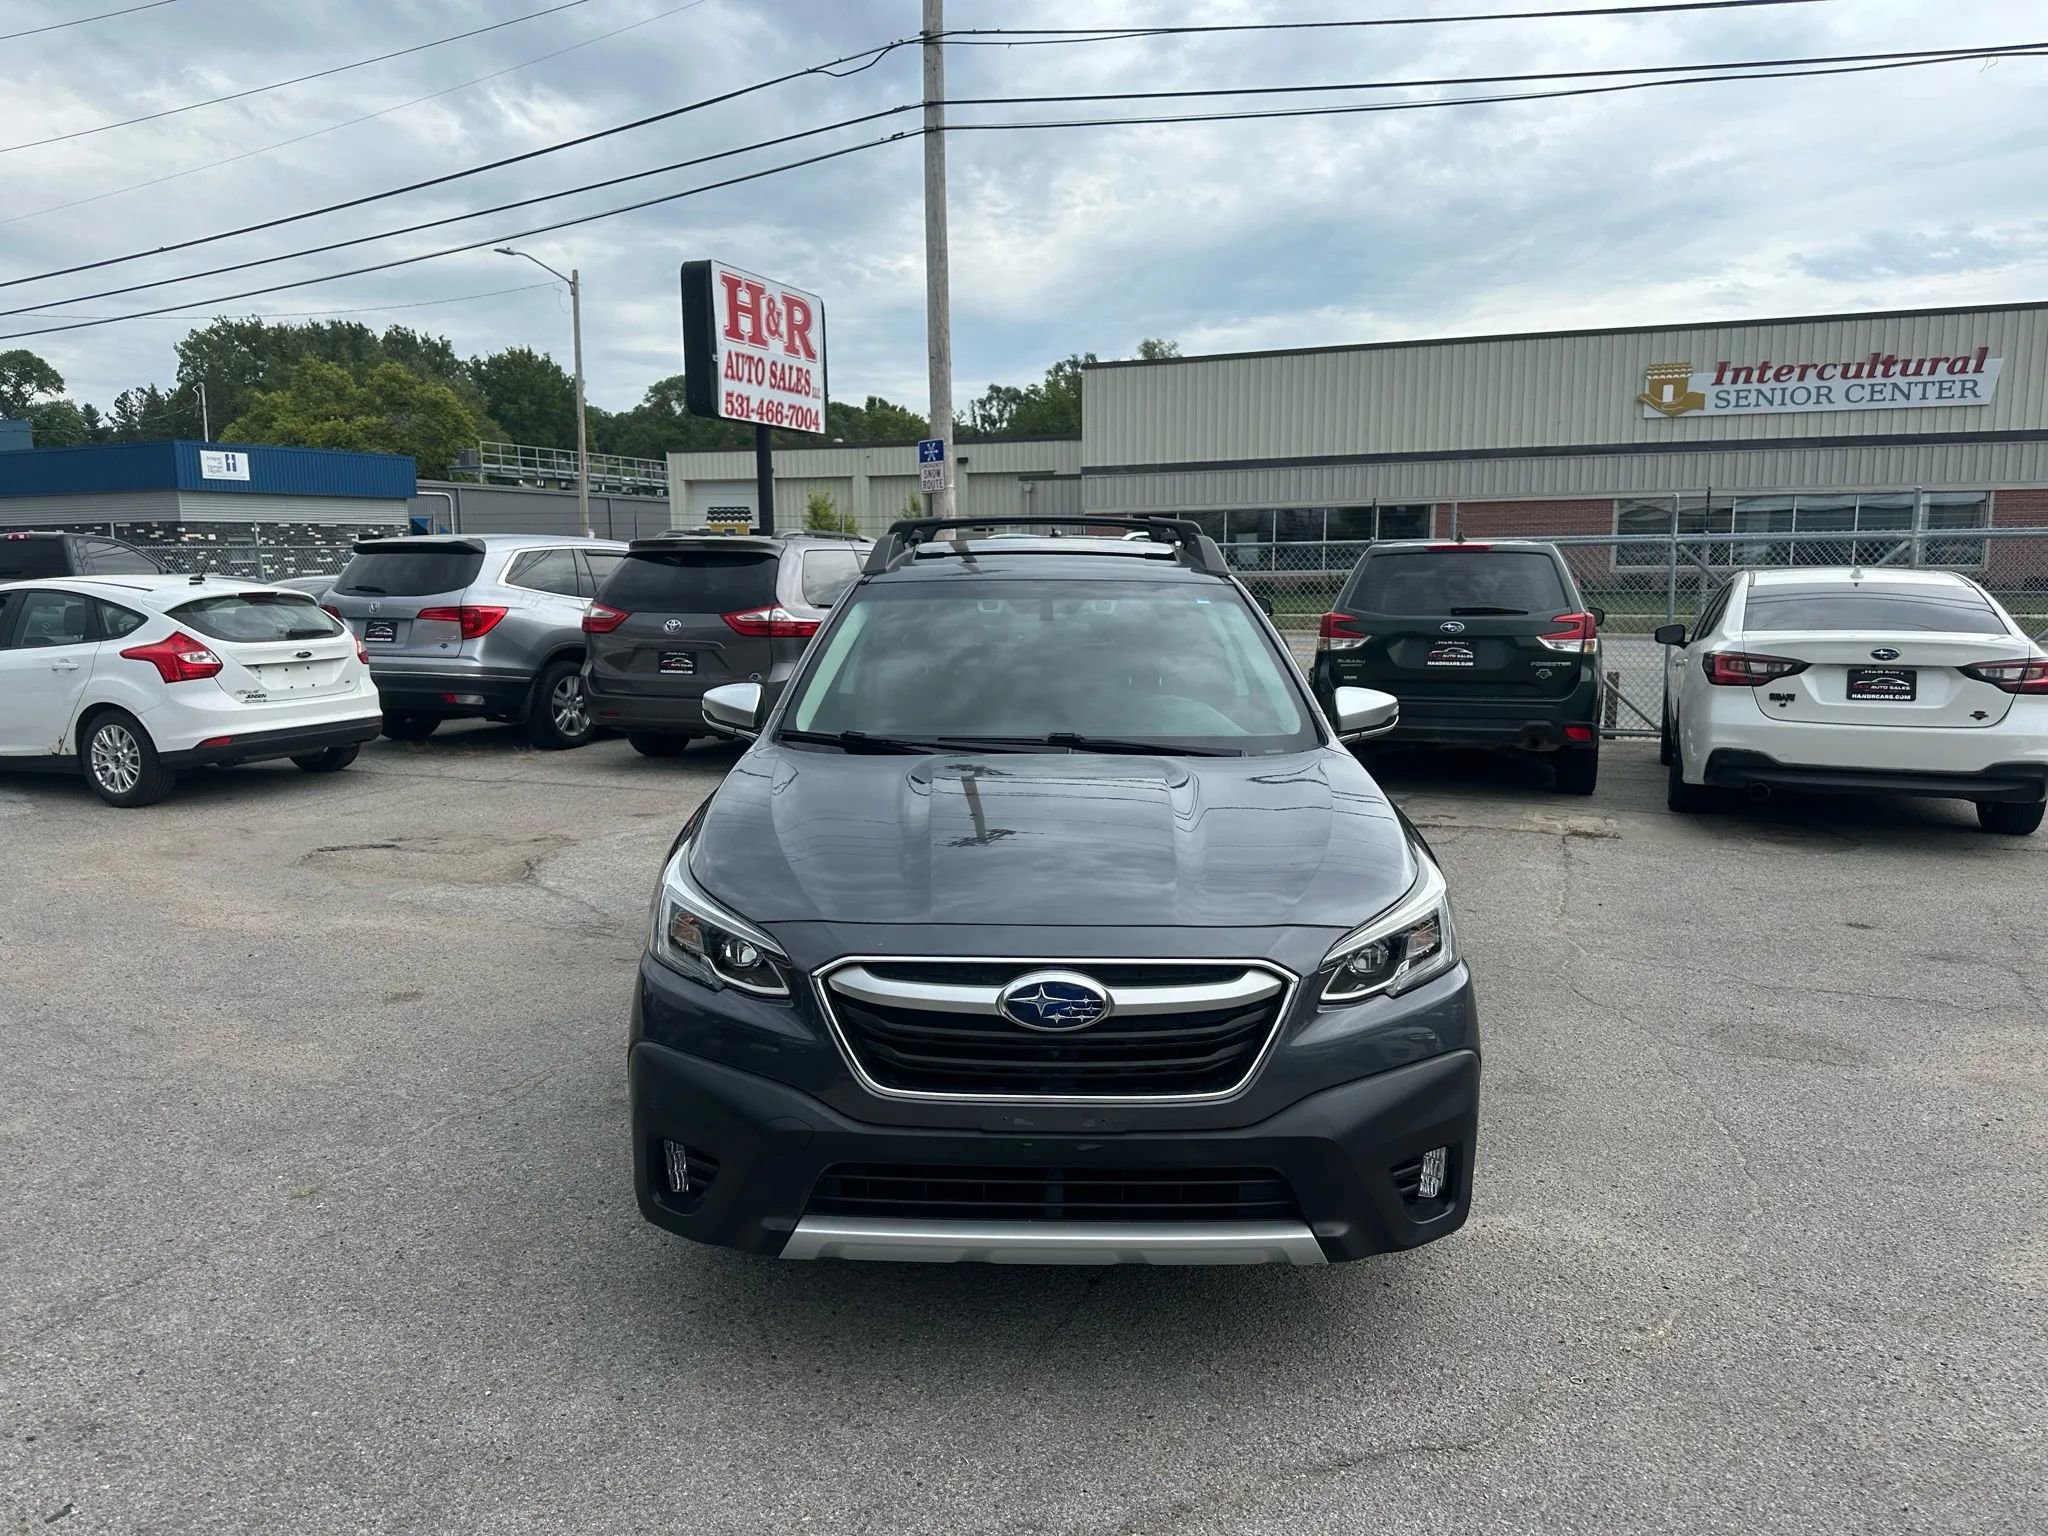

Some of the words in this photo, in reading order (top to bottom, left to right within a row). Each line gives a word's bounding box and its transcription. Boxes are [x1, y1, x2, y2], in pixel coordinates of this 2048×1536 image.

[720, 271, 817, 363] H&R
[724, 350, 766, 386] AUTO
[769, 361, 811, 396] SALES
[1711, 347, 1989, 386] Intercultural
[725, 390, 820, 433] 531-466-7004
[1714, 385, 1835, 409] SENIOR
[1844, 378, 1981, 404] CENTER
[922, 479, 944, 490] ROUTE
[923, 469, 941, 479] SNOW
